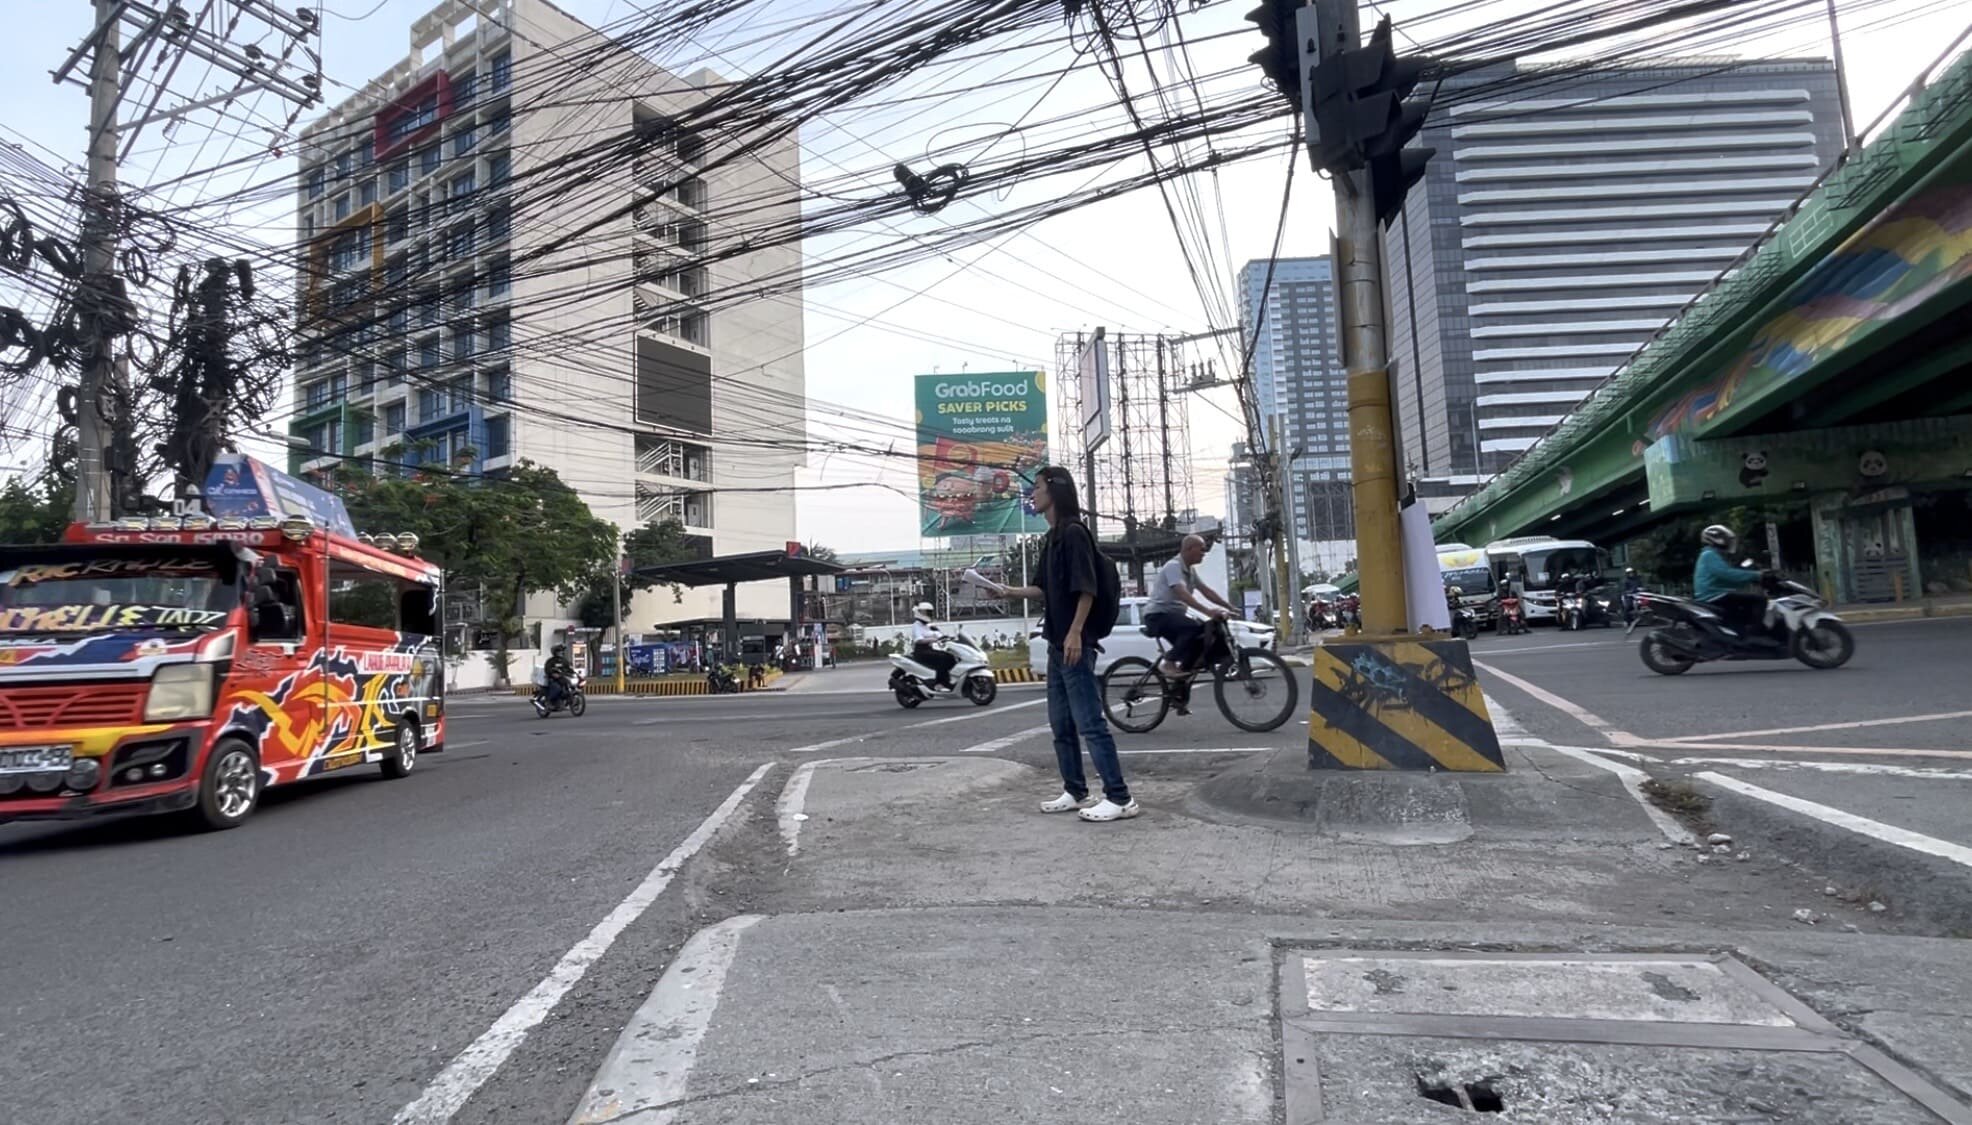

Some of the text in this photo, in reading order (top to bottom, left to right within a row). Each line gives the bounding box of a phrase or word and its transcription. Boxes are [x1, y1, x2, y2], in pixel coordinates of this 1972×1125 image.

[935, 380, 1028, 398] GrabFood
[937, 401, 1027, 414] SAVER PICKS
[952, 417, 974, 426] Tasty
